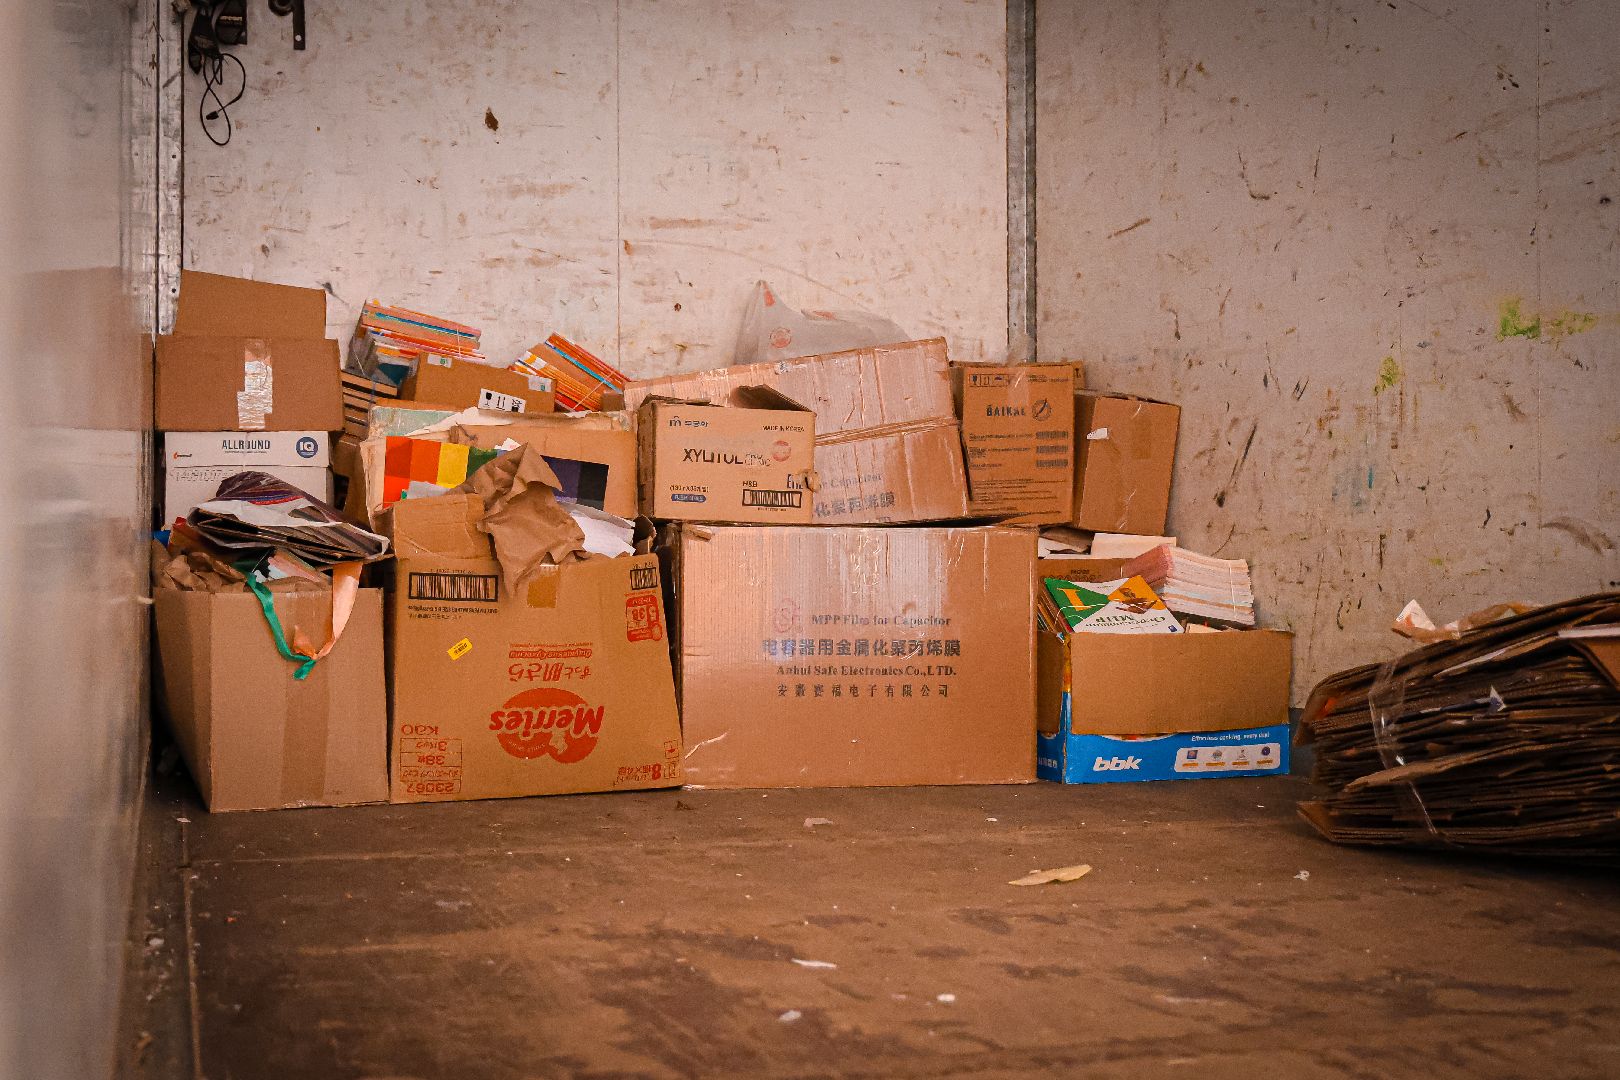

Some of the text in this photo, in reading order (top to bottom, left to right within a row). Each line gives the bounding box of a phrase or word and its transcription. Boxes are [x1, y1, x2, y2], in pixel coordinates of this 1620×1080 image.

[222, 439, 271, 450] ALLROUND
[299, 441, 315, 452] IQ
[811, 614, 952, 628] MPP Film for Capacitor
[776, 665, 812, 676] Anhui
[814, 665, 838, 676] Safe
[841, 665, 903, 676] Electronics
[488, 705, 605, 738] Merries
[1093, 756, 1142, 771] bbk
[406, 782, 455, 793] 23067
